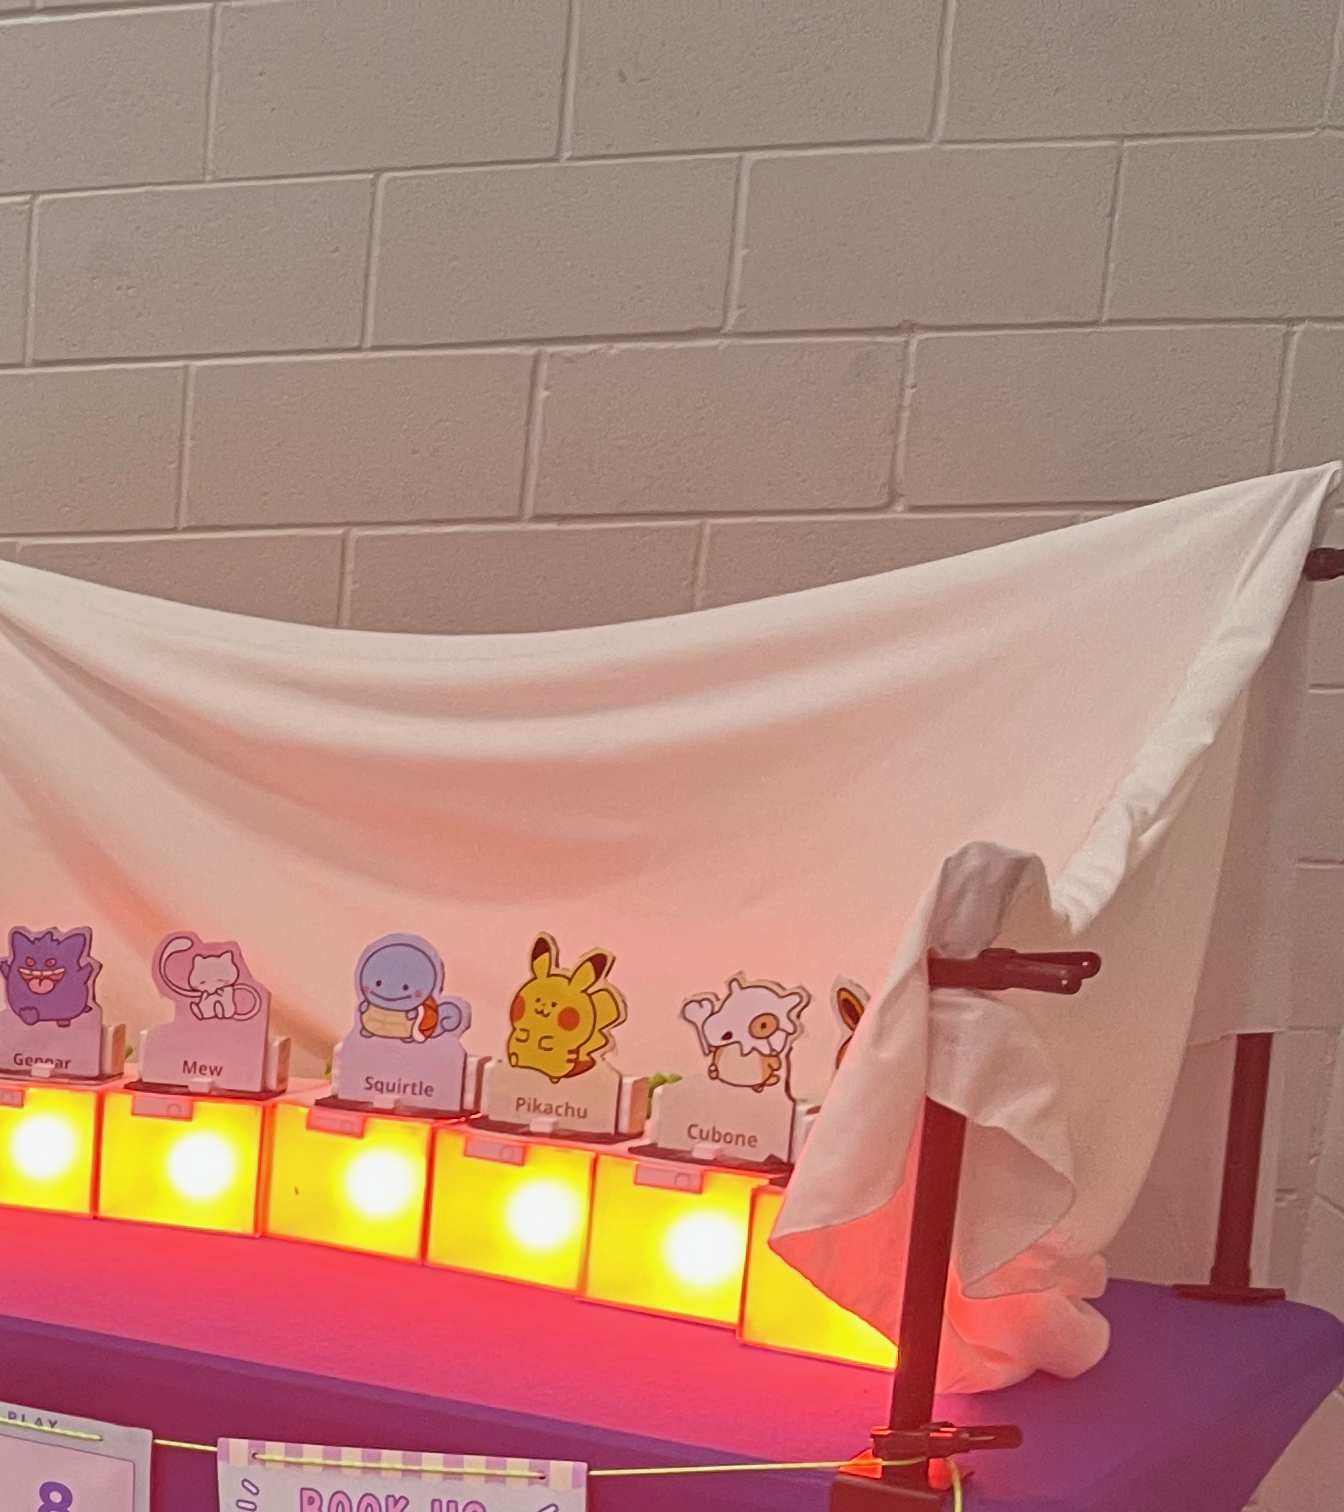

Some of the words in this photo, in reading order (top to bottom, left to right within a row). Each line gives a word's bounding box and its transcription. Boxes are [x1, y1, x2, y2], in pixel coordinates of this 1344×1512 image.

[182, 1058, 224, 1079] Mew
[363, 1074, 434, 1099] Squirtle
[515, 1095, 588, 1121] Pikachu
[686, 1122, 759, 1150] Cubone
